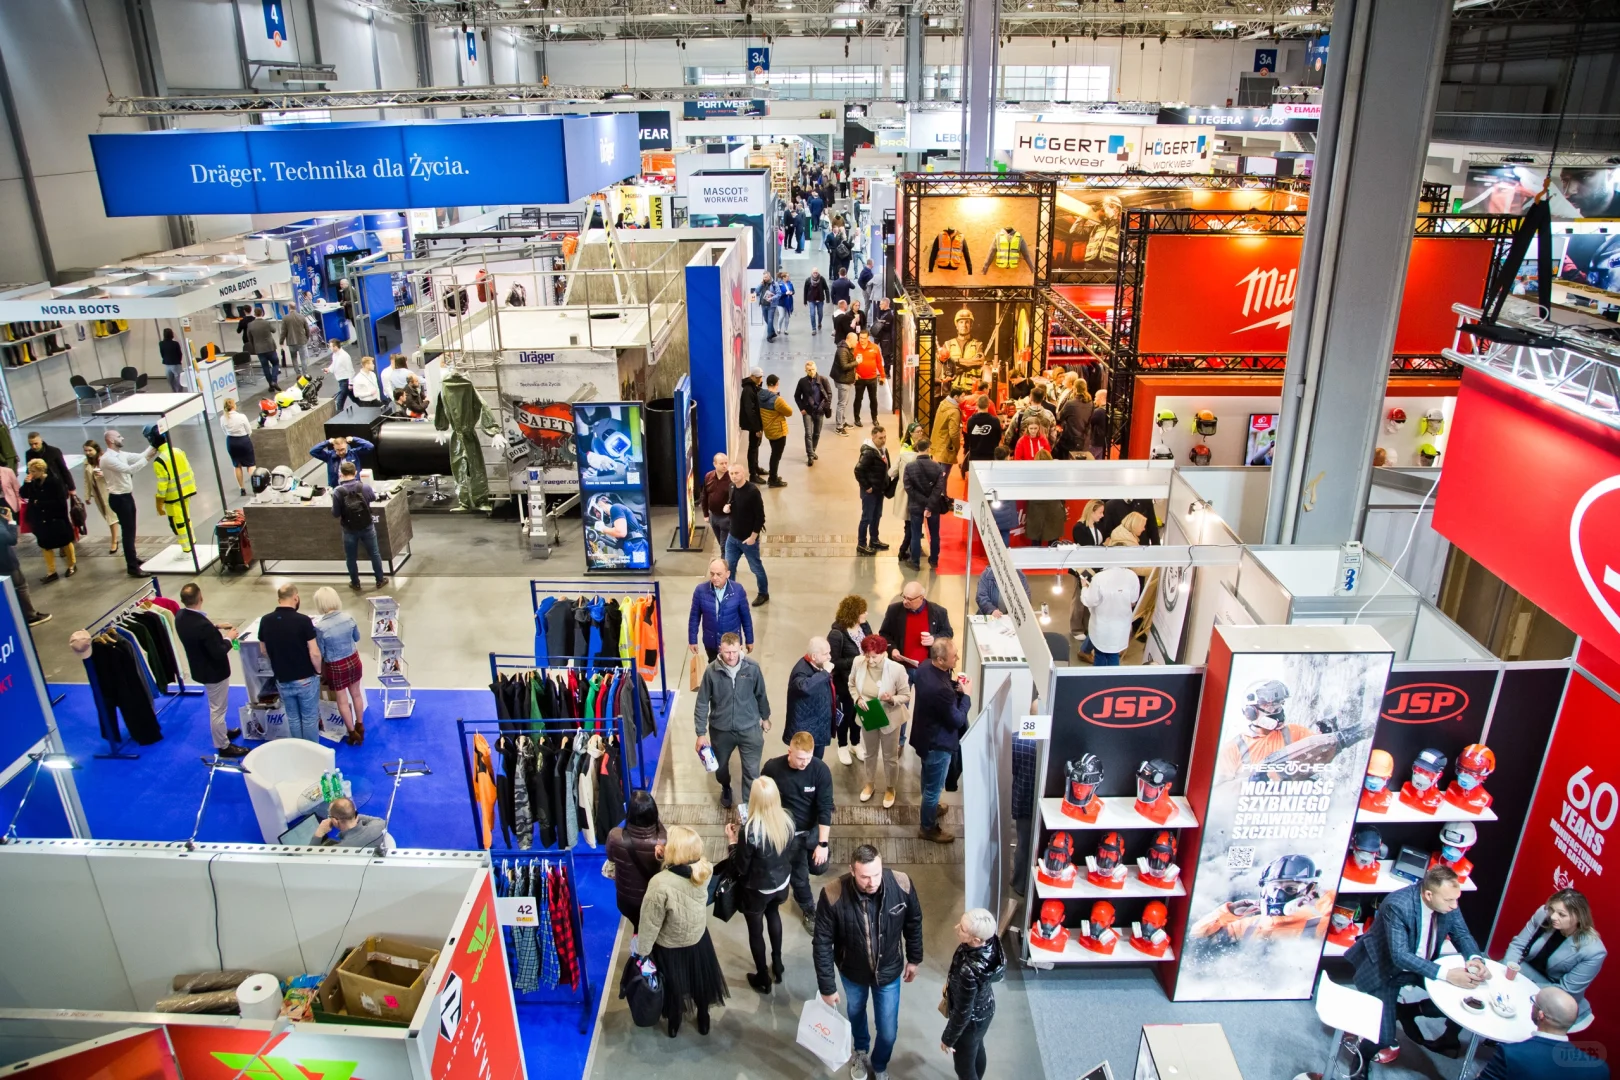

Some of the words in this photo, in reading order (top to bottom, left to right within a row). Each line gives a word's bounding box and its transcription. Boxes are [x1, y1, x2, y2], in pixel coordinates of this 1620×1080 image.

[270, 4, 279, 24] 4
[469, 38, 474, 50] 4
[752, 52, 766, 63] 3A
[1258, 53, 1273, 65] 3A
[1019, 133, 1107, 152] HÖGERT
[1145, 137, 1197, 155] HÖGERT
[190, 163, 267, 188] Dräger.
[270, 159, 368, 182] Technika
[372, 158, 405, 178] dla
[409, 152, 470, 182] Życia.
[1033, 154, 1105, 168] workwear
[1153, 158, 1195, 170] workwear
[654, 197, 663, 228] EVENT
[219, 284, 237, 297] NORA
[237, 277, 258, 291] BOOTS
[1234, 266, 1298, 318] Mil
[41, 304, 76, 315] NORA
[78, 304, 121, 315] BOOTS
[519, 351, 555, 364] Dräger
[211, 371, 235, 392] nora
[509, 445, 528, 459] BORN
[1092, 695, 1162, 719] JSP
[1388, 691, 1457, 715] JSP
[1022, 721, 1036, 730] 38
[1240, 778, 1335, 796] MOŻLIWOŚĆ
[1237, 795, 1331, 812] SZYBKIEGO
[1566, 765, 1619, 831] 60
[1234, 811, 1327, 826] SPRAWDZENIA
[1231, 824, 1325, 840] SZCZELNOŚCI
[1560, 799, 1605, 857] YEARS
[1549, 817, 1604, 877] MANUFACTURING
[1554, 835, 1568, 855] FOR
[1566, 847, 1592, 877] SAFETY
[517, 904, 533, 915] 42
